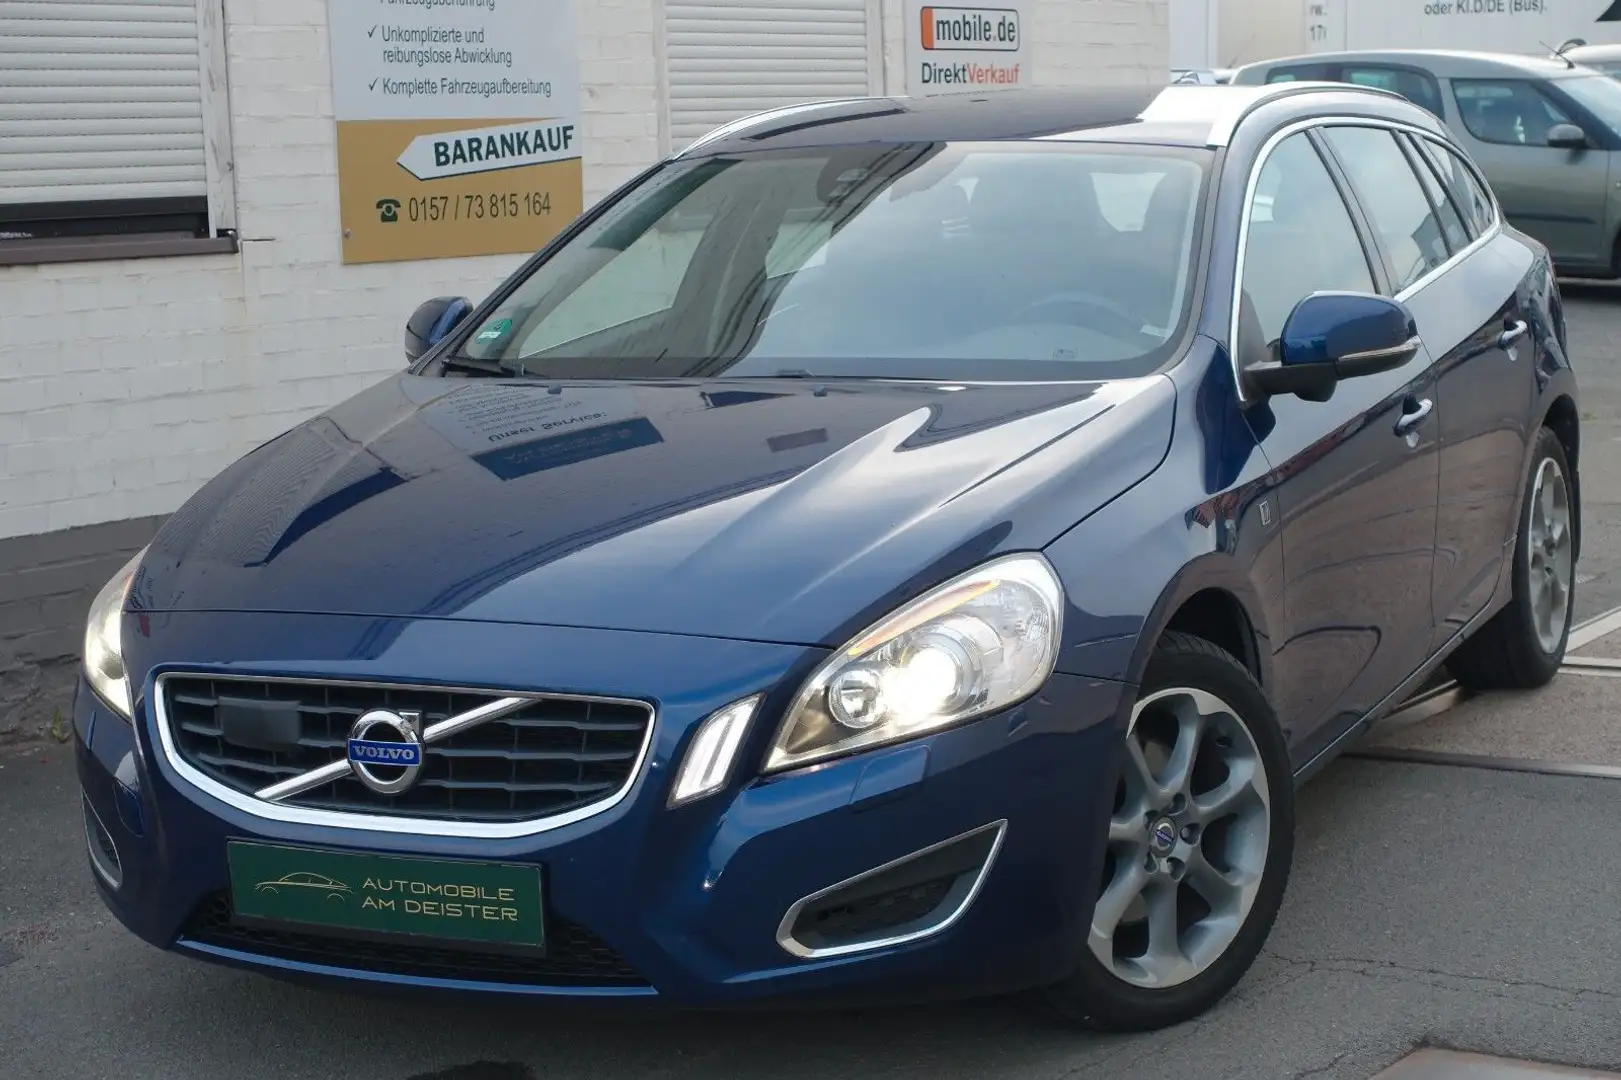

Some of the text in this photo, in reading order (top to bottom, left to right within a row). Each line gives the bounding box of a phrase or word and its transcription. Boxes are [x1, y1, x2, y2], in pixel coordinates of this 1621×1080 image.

[1424, 0, 1453, 15] oder
[382, 25, 485, 45] Unkomplizierte und
[935, 14, 1016, 42] mobile.de
[383, 47, 512, 67] reibungslose Abwicklung
[921, 62, 1020, 84] DirektVerkauf
[383, 77, 552, 98] Komplette Fahrzeugaufbereitung
[434, 125, 574, 167] BARANKAUF
[409, 192, 552, 221] 0157 / 73 815 164
[353, 745, 415, 761] VOLVO
[362, 878, 515, 901] AUTOMOBILE
[362, 896, 518, 921] AM DEISTER
